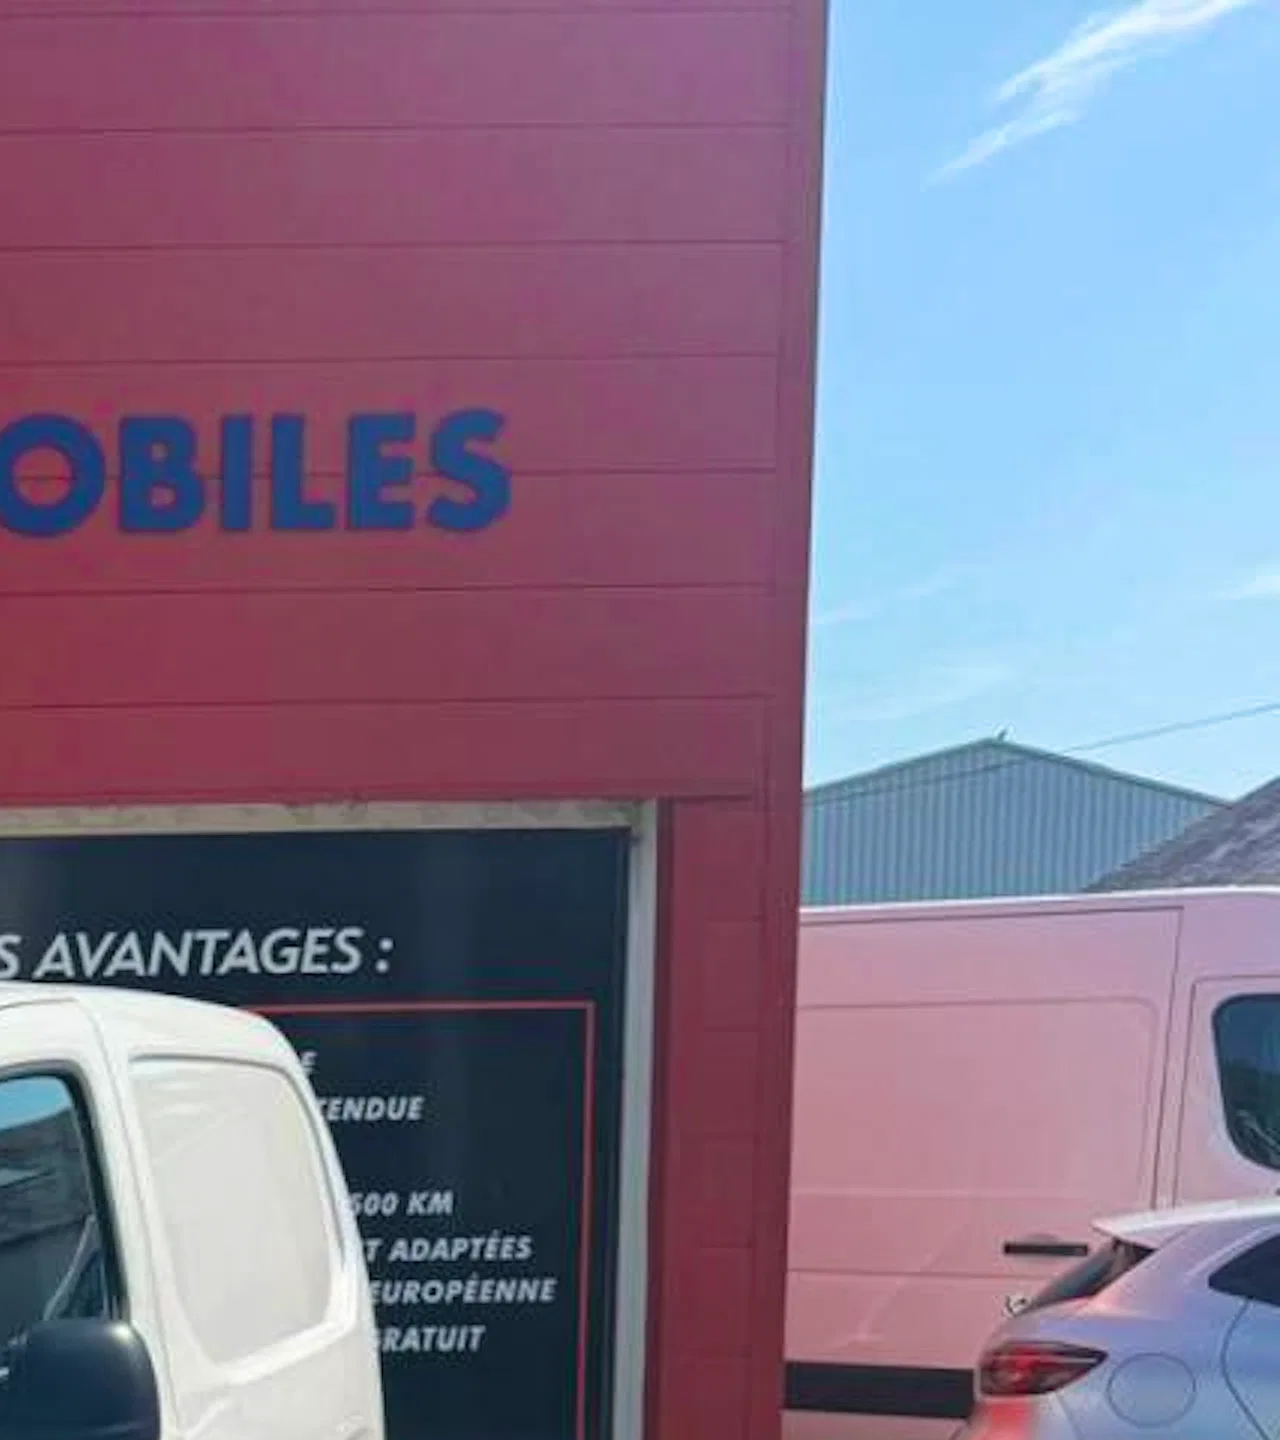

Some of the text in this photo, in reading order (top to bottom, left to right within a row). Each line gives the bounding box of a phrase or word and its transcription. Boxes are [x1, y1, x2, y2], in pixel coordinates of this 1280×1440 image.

[31, 928, 364, 978] AVANTAGES
[315, 1096, 425, 1121] TENDUE
[406, 1189, 454, 1216] KM
[388, 1228, 533, 1262] ADAPTÉES
[379, 1324, 487, 1352] RATUIT
